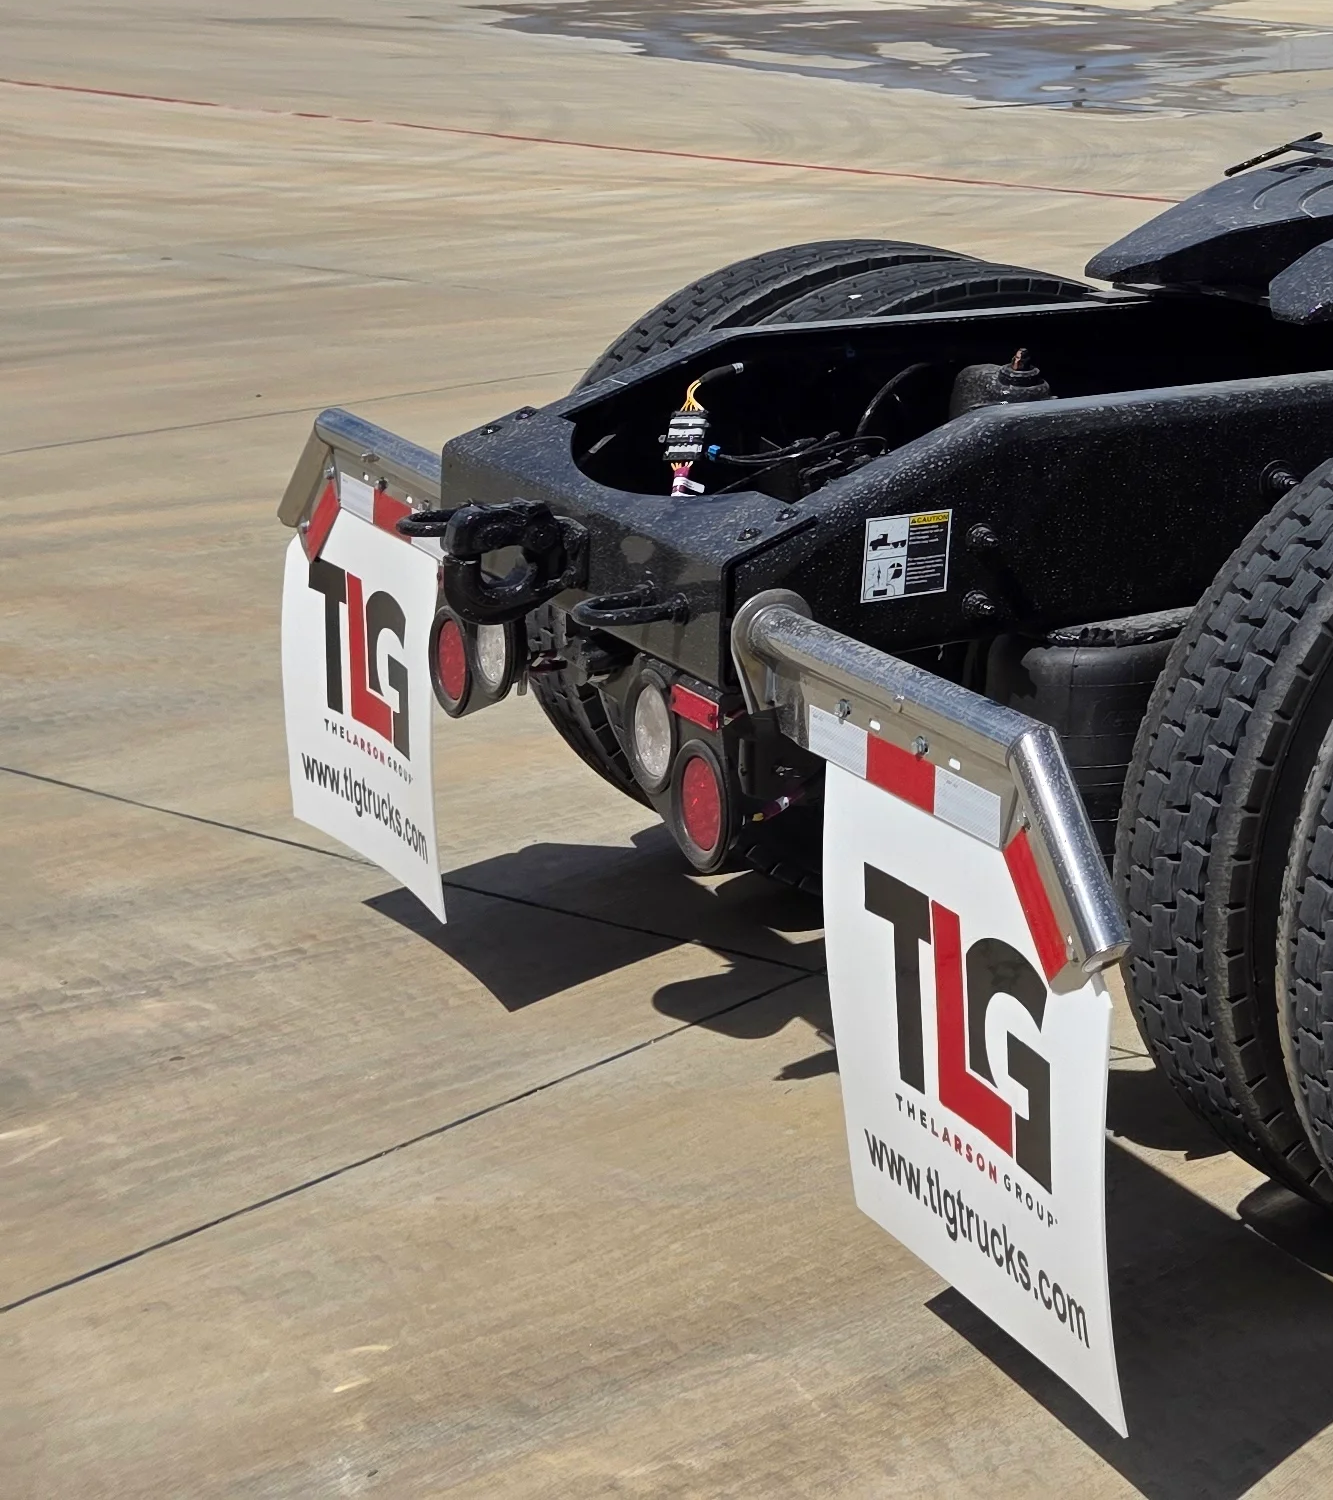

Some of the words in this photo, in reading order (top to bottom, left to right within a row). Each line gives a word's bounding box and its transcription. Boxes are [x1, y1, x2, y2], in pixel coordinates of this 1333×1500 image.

[916, 514, 948, 523] CAUTION
[309, 557, 411, 762] TLG
[301, 752, 429, 865] www.tlgtrucks.com
[387, 755, 412, 786] GROUP
[863, 861, 1053, 1195] TLG
[863, 1128, 1091, 1349] www.tlgtrucks.com
[1003, 1173, 1056, 1228] GROUP
